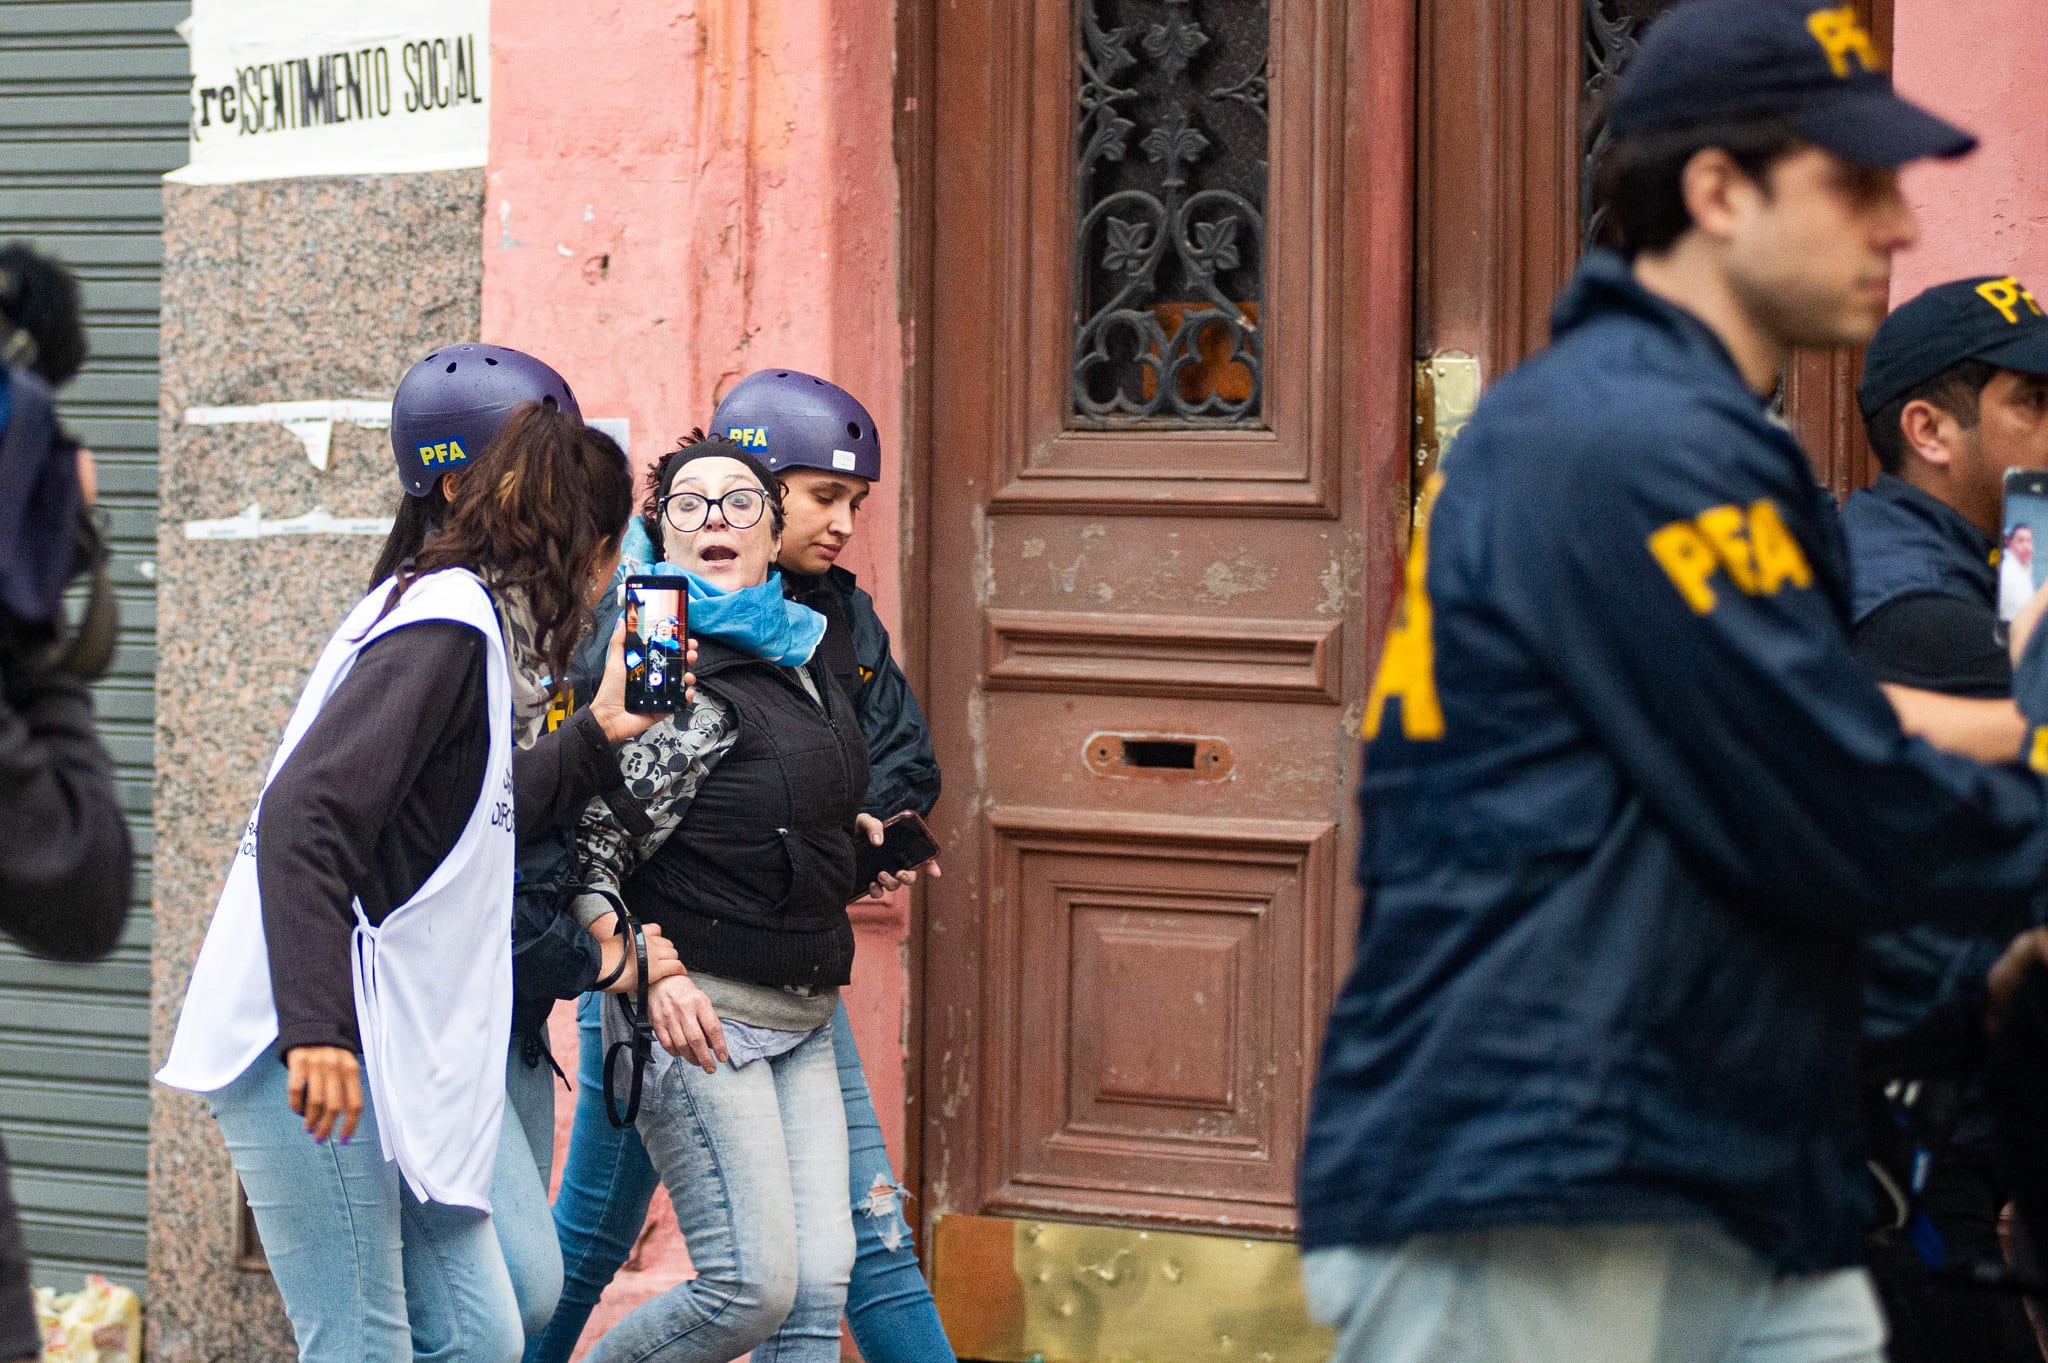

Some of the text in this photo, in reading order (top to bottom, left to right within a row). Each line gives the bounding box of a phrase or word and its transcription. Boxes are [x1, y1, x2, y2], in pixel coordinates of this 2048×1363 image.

[402, 33, 482, 113] SOCIAL
[419, 441, 466, 466] PFA
[729, 428, 768, 447] PFA
[1648, 497, 1813, 616] PFA
